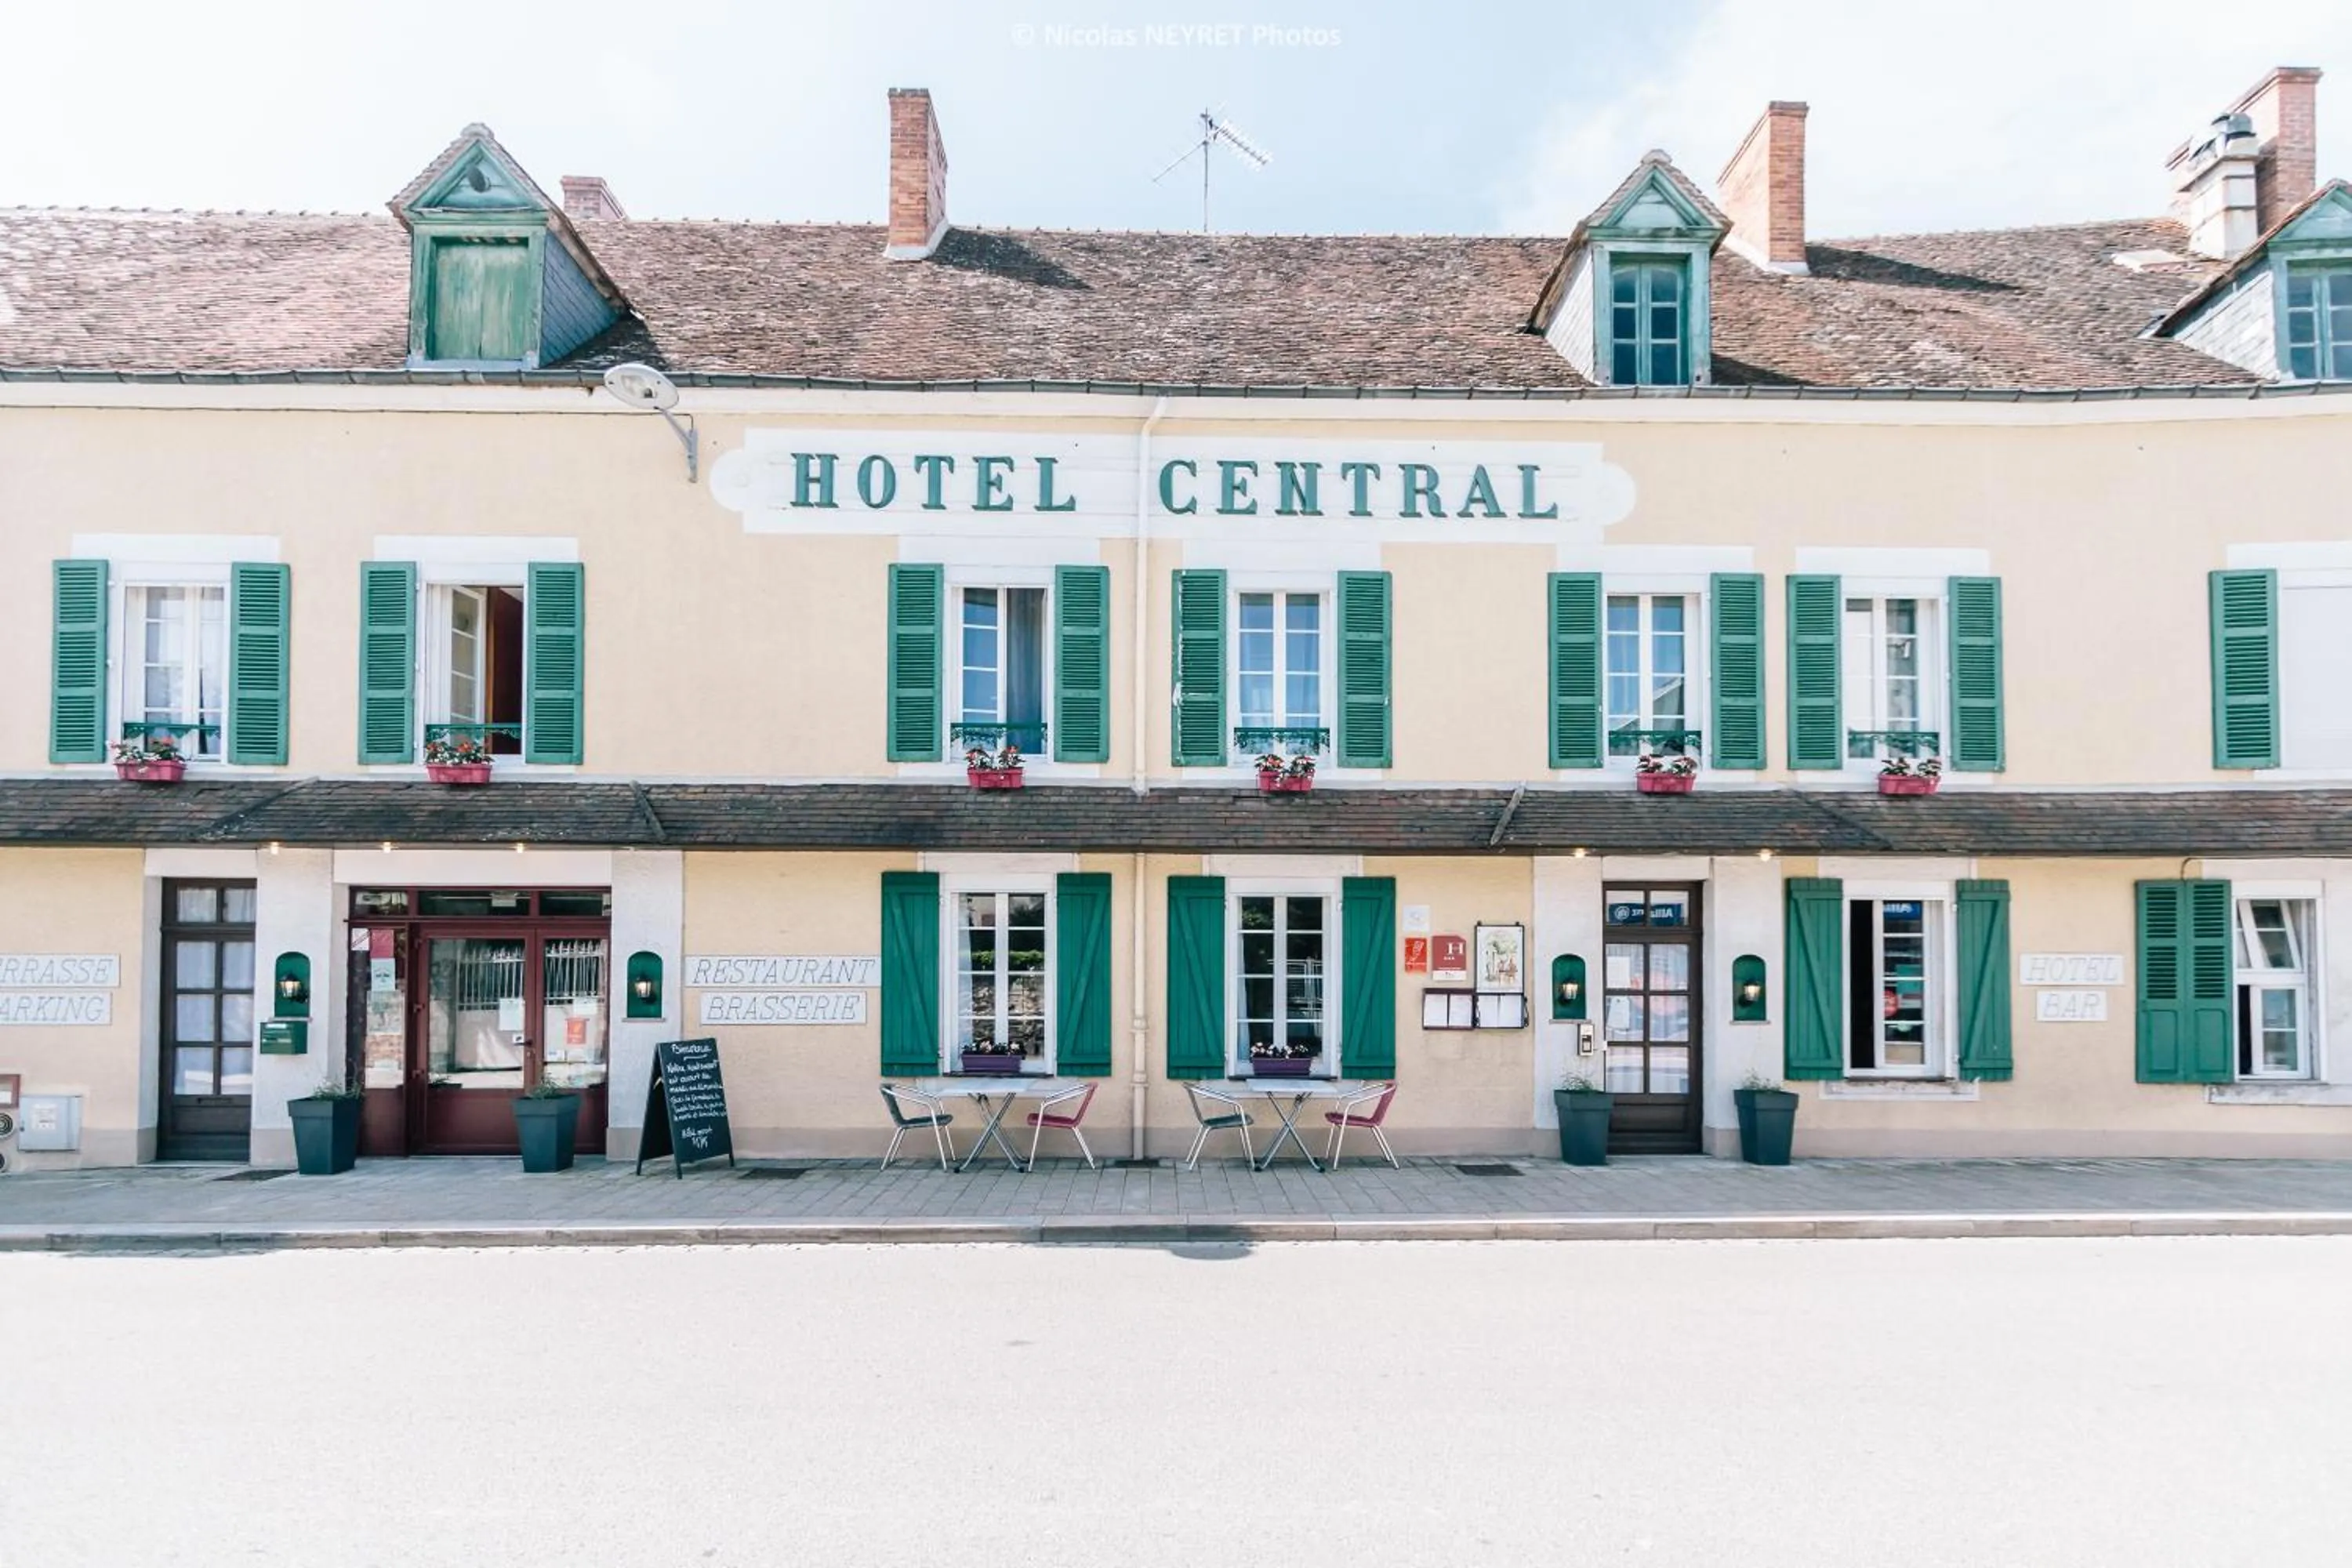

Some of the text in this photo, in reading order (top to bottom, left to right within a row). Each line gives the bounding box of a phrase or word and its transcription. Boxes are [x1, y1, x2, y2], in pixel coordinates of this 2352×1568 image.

[789, 452, 1559, 519] HOTEL CENTRAL
[0, 958, 114, 984] RRASSE
[692, 959, 876, 984] RESTAURANT
[2025, 956, 2122, 981] HOTEL
[0, 996, 104, 1022] ARKING
[707, 995, 860, 1021] BRASSERIE
[2043, 993, 2101, 1018] BAR
